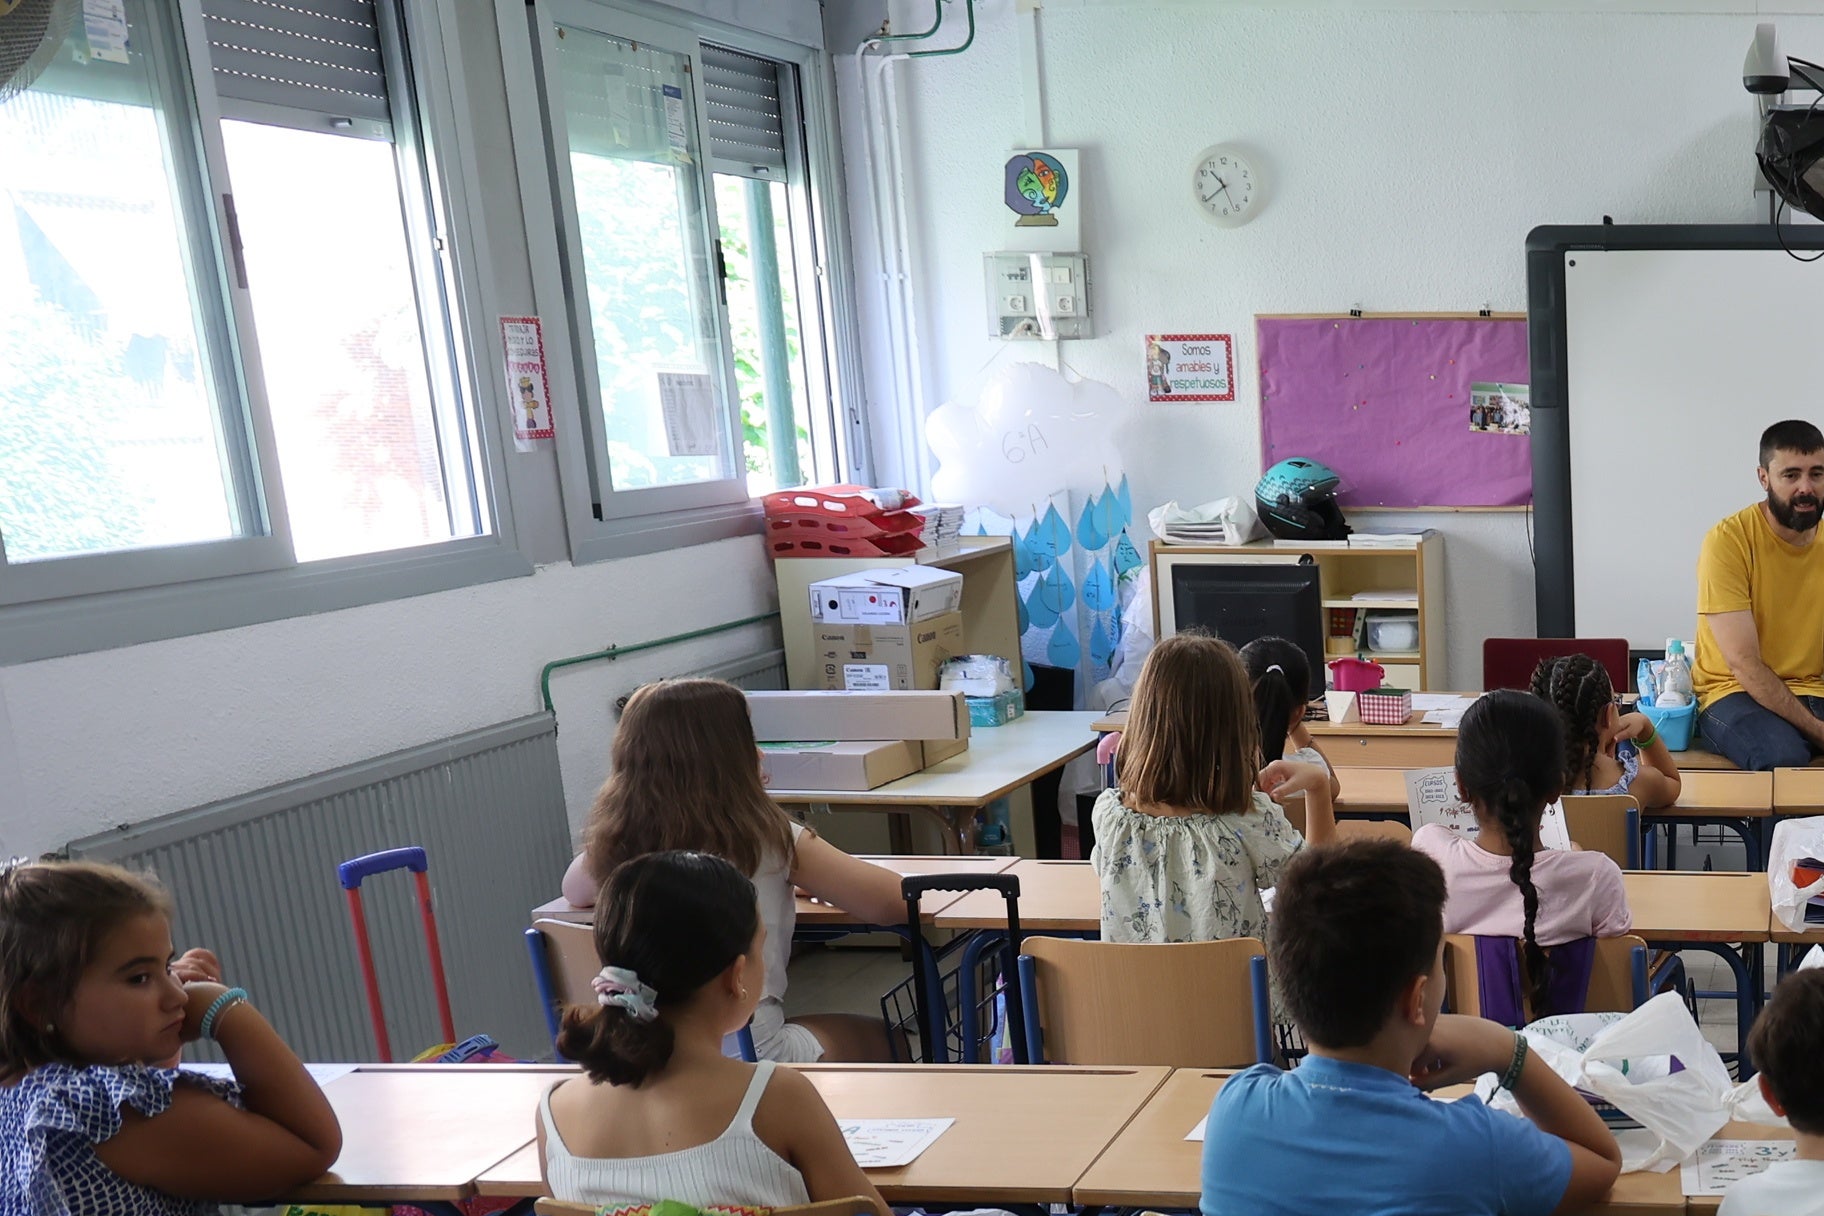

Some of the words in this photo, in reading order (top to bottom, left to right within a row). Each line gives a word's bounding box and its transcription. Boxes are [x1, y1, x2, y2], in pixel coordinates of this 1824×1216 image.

[1220, 156, 1227, 165] 12
[1246, 183, 1252, 191] 3
[1222, 207, 1228, 216] 6
[1182, 343, 1211, 356] Somos
[1176, 360, 1212, 372] amables
[1213, 363, 1220, 375] y
[917, 631, 936, 644] Canon
